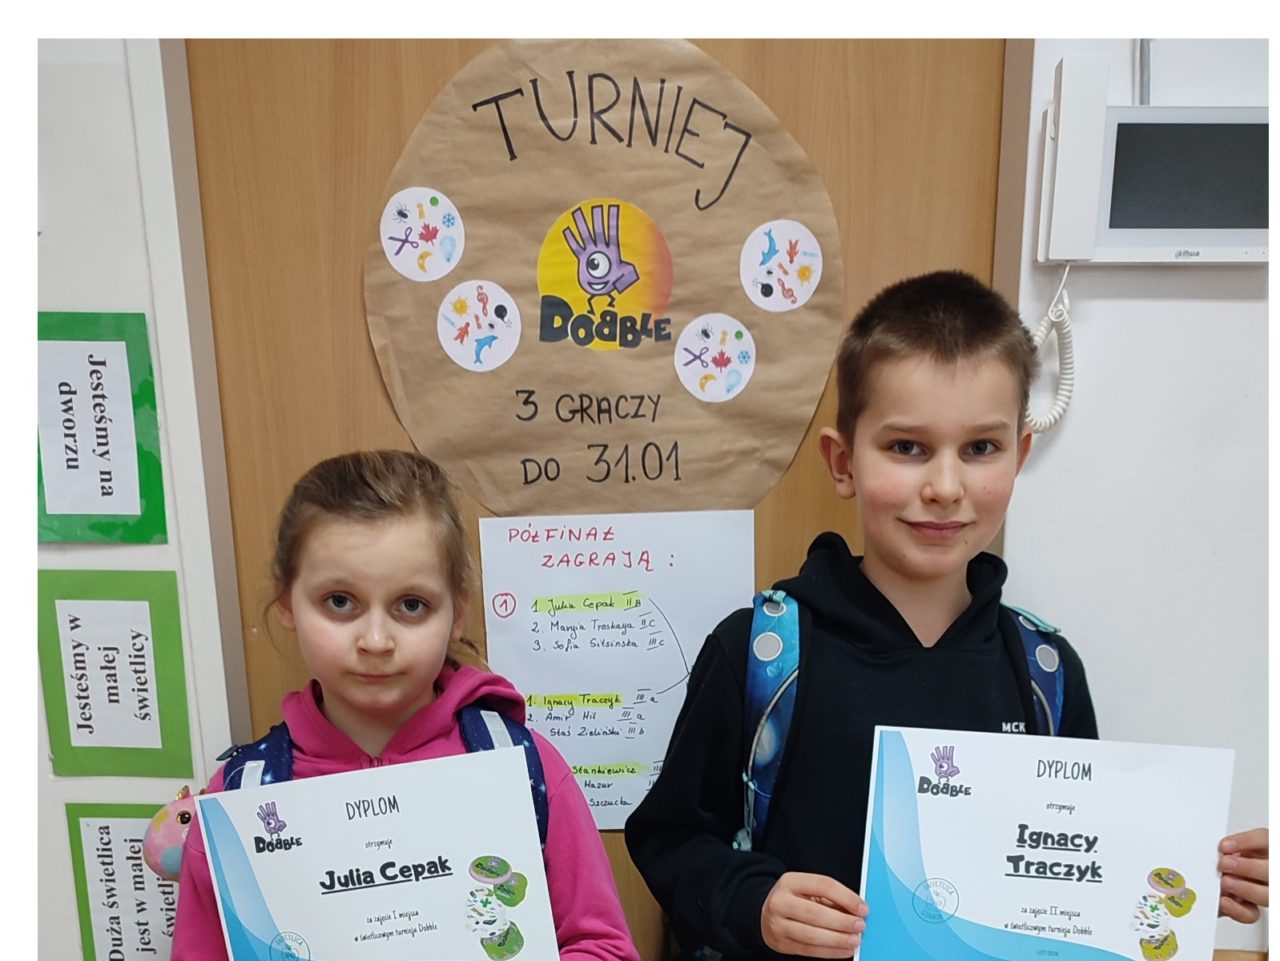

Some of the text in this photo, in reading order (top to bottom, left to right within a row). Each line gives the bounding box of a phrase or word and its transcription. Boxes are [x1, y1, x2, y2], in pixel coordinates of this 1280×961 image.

[472, 70, 752, 211] TURNIEJ
[515, 389, 661, 425] 3 GRACZY
[57, 381, 80, 470] dworzu
[87, 354, 114, 497] Jesteśmy na
[520, 440, 682, 485] DO 31.01
[541, 550, 654, 572] ZAGRAJĄ
[548, 598, 576, 616] Julia
[582, 597, 616, 611] Cepak
[68, 613, 94, 734] Jesteśmy w
[97, 646, 120, 704] małej
[128, 628, 151, 721] świetlicy
[544, 695, 576, 716] Ignacy
[578, 694, 622, 710] Traczyk
[1002, 722, 1026, 734] MCK
[1036, 759, 1092, 782] DYPLOM
[346, 795, 400, 820] DYPLOM
[1046, 802, 1076, 816] otrzymuje
[365, 838, 393, 851] otrzymuje
[1016, 823, 1099, 854] Ignacy
[96, 824, 120, 909] świetlica
[318, 868, 376, 893] Julia
[379, 855, 454, 884] Cepak
[1004, 854, 1103, 883] Traczyk
[124, 837, 158, 955] jest w małej
